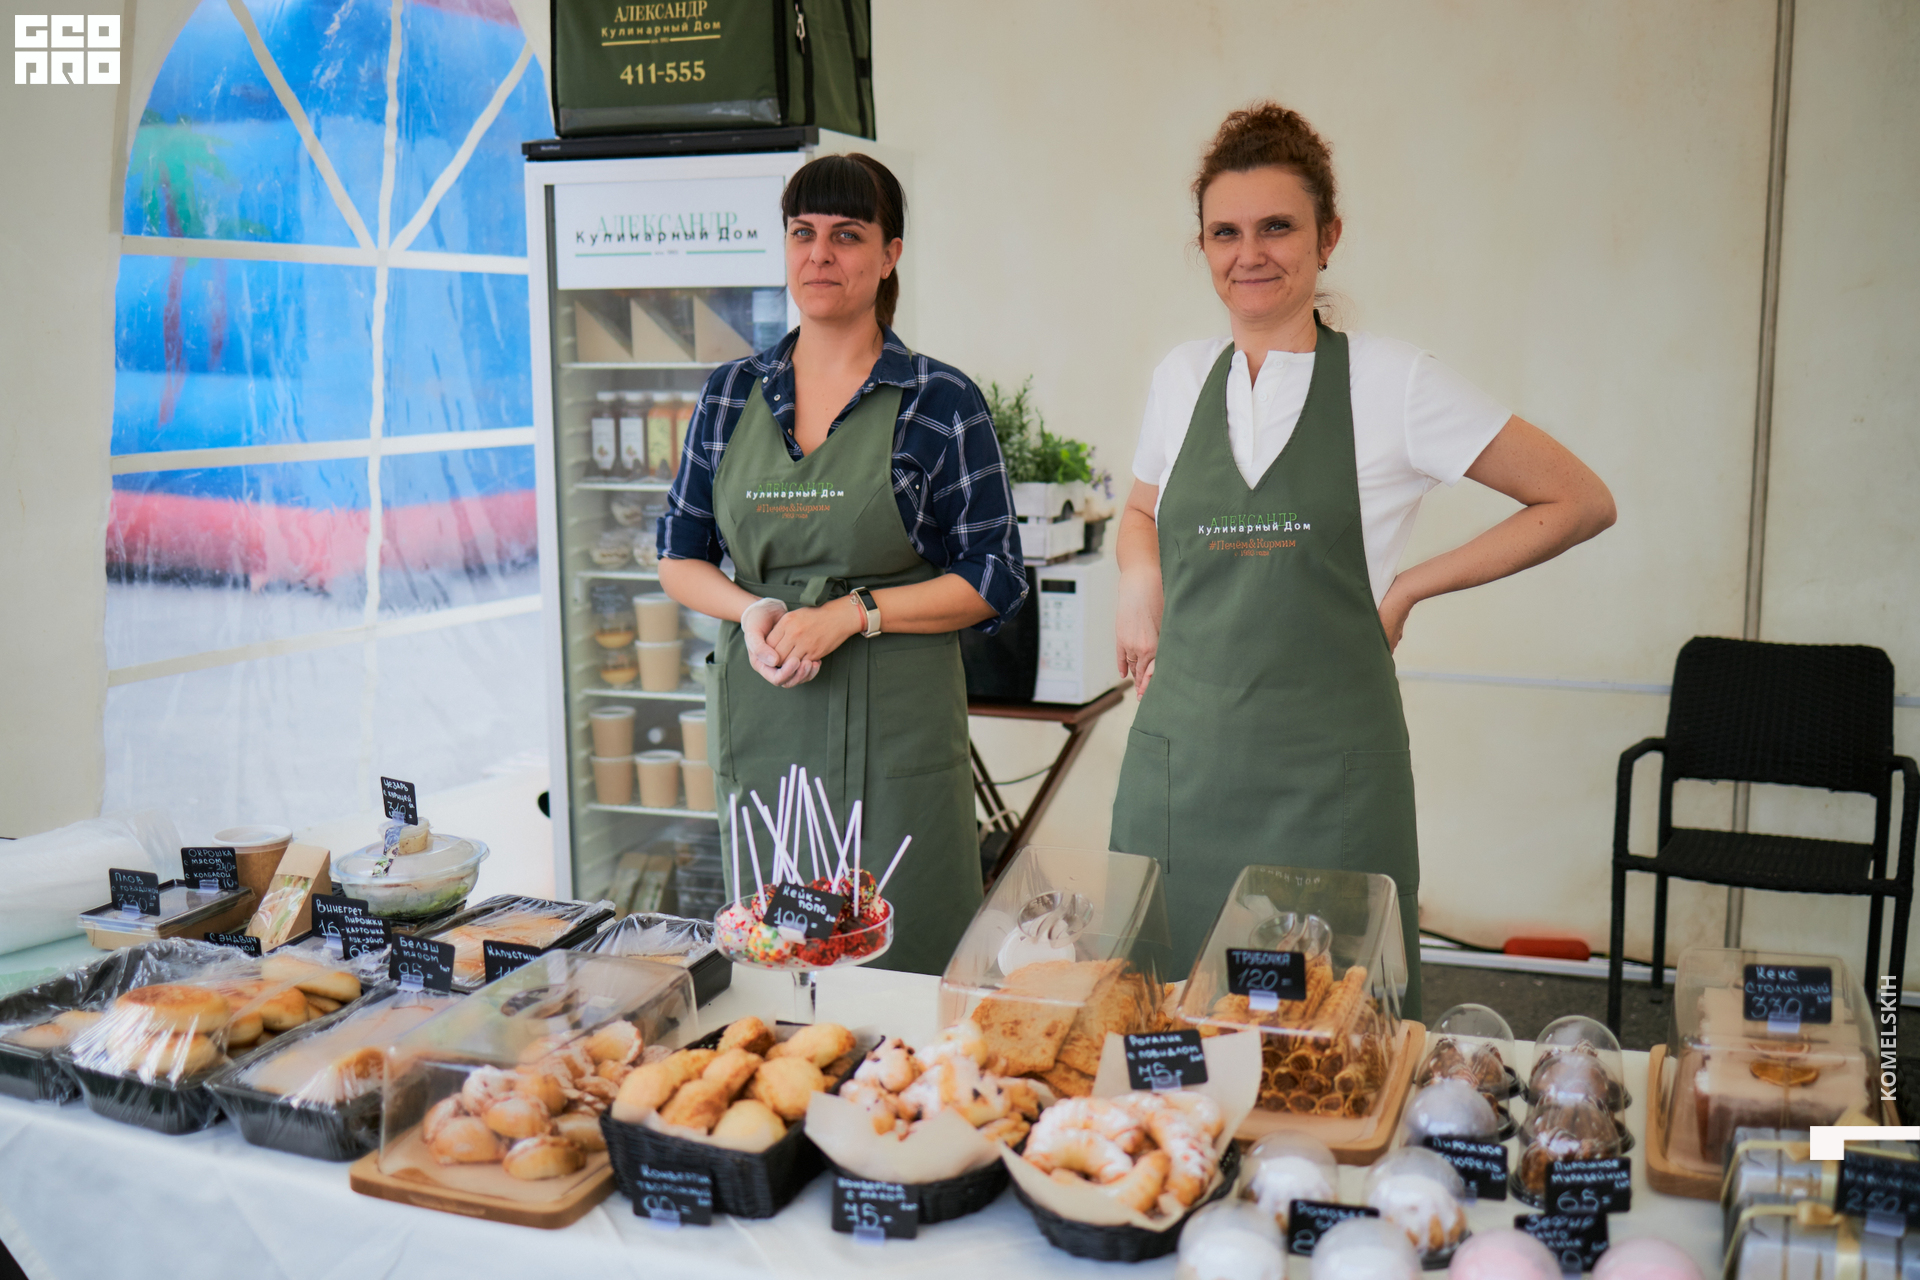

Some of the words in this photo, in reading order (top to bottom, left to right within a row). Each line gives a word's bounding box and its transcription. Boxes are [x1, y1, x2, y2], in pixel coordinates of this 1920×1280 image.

[614, 1, 708, 23] АЛЕКСАНДР
[601, 22, 689, 39] Кулинарный
[694, 20, 721, 33] Дом
[620, 60, 706, 85] 411-555
[597, 211, 738, 237] АЛЕКСАНДР
[576, 228, 708, 246] Кулинарный
[718, 226, 758, 242] Дом
[746, 489, 817, 500] Кулинарный
[820, 489, 844, 498] Дом
[1198, 522, 1279, 536] Кулинарный
[1284, 521, 1311, 532] Дом
[1210, 512, 1298, 530] АЛЕКСАНДР
[1208, 538, 1296, 551] #Печём&Кормим
[1756, 966, 1798, 981] Кекс
